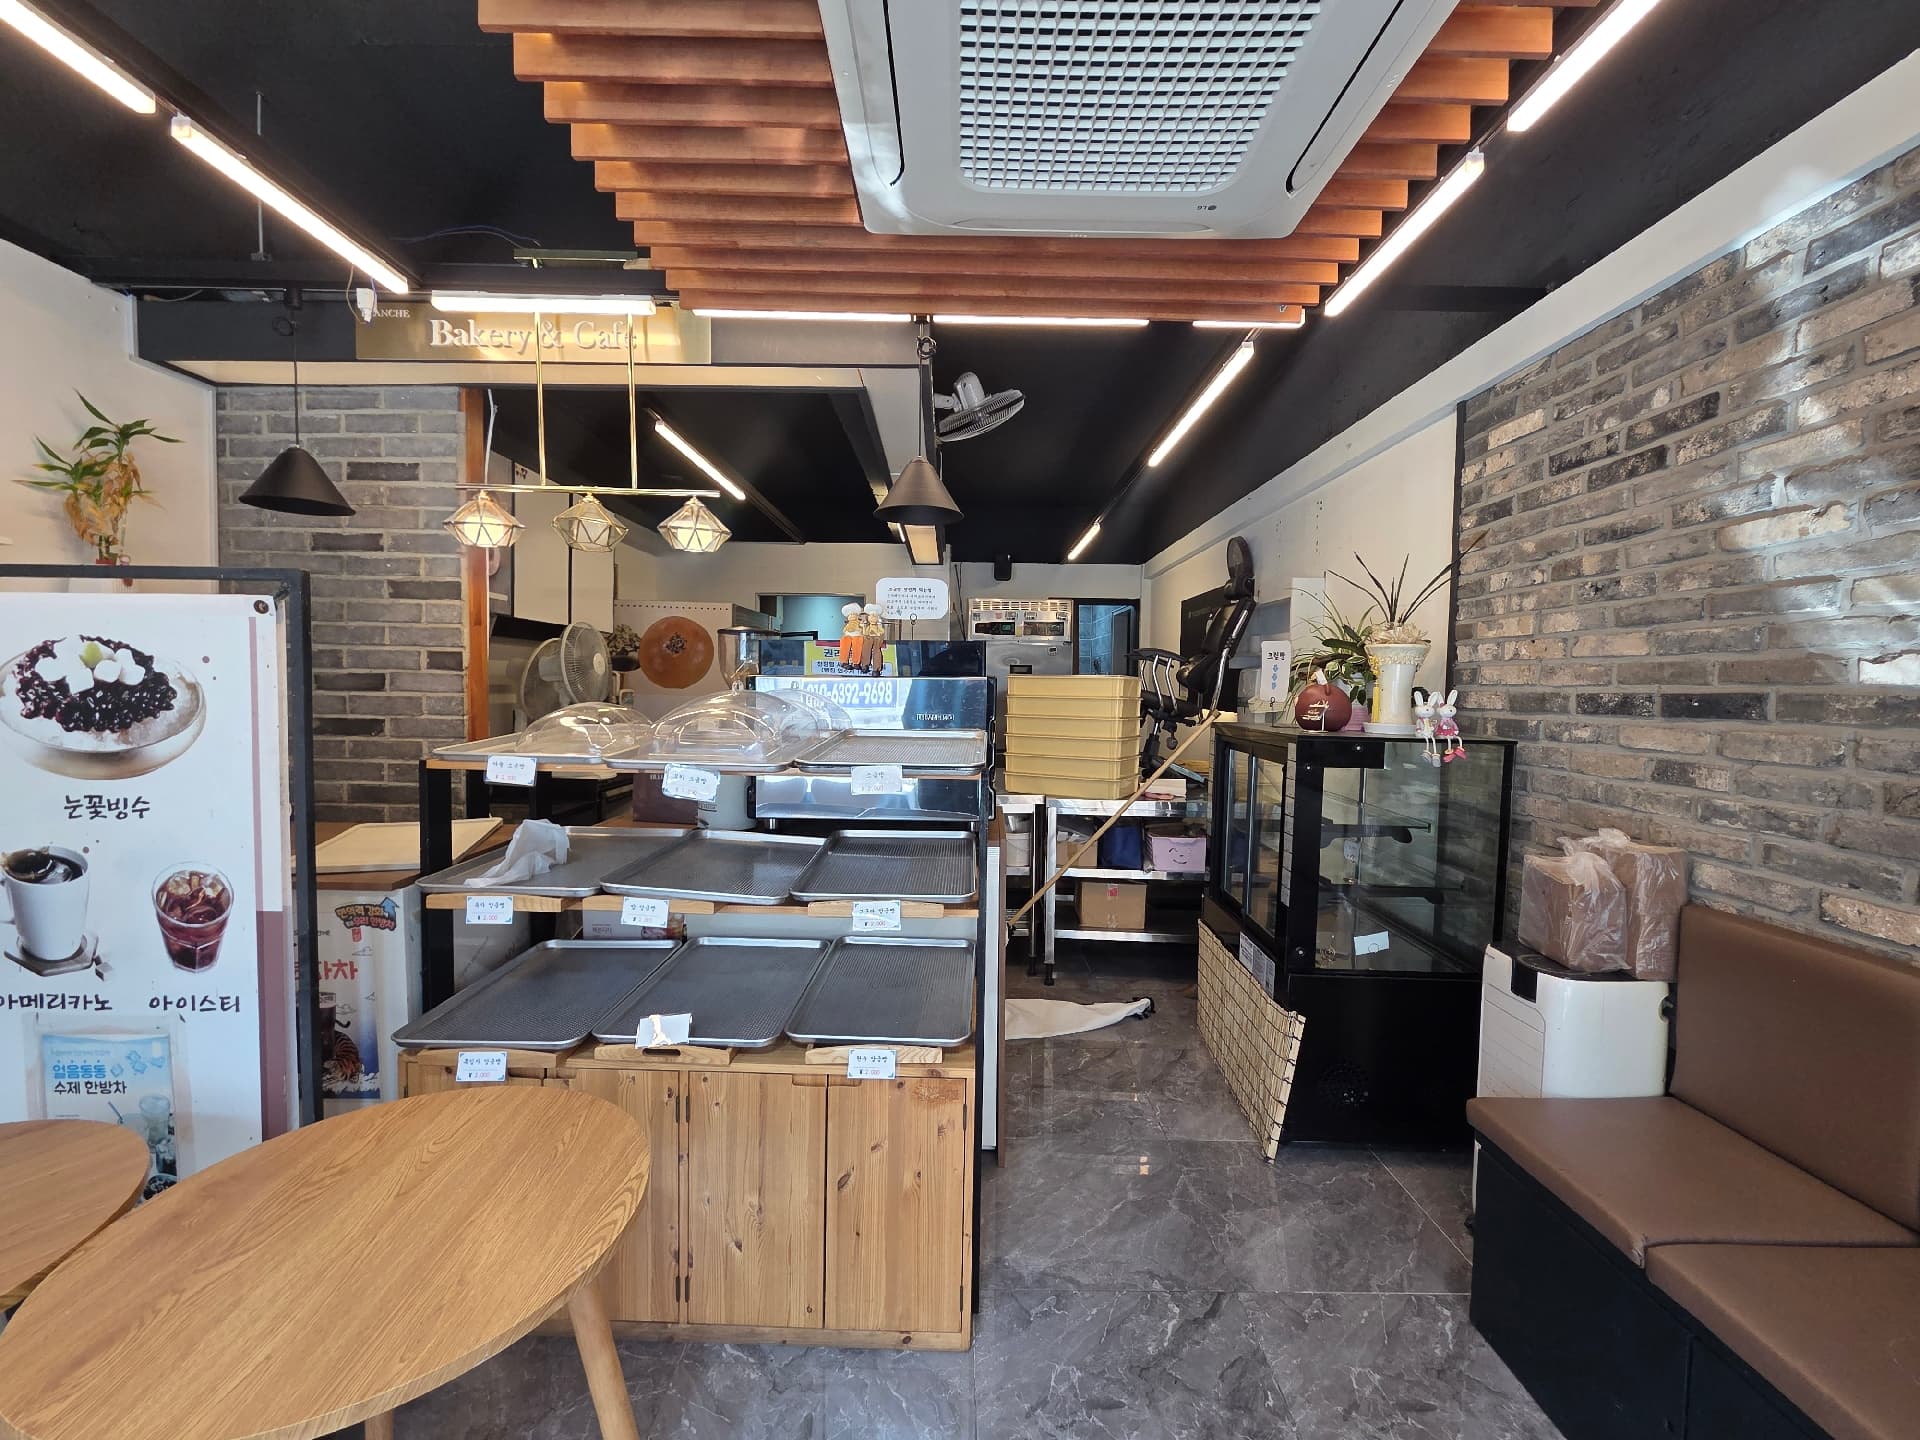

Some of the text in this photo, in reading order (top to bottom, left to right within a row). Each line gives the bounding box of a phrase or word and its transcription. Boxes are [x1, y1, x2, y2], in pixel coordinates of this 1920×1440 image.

[361, 309, 411, 318] ANCHE
[430, 319, 532, 355] Bakery
[541, 320, 564, 349] &
[64, 795, 151, 819] 눈꽃빙수
[0, 993, 240, 1013] 아메리카노 아이스티
[53, 1064, 106, 1079] 얼음동동
[54, 1080, 127, 1095] 수제 한방차
